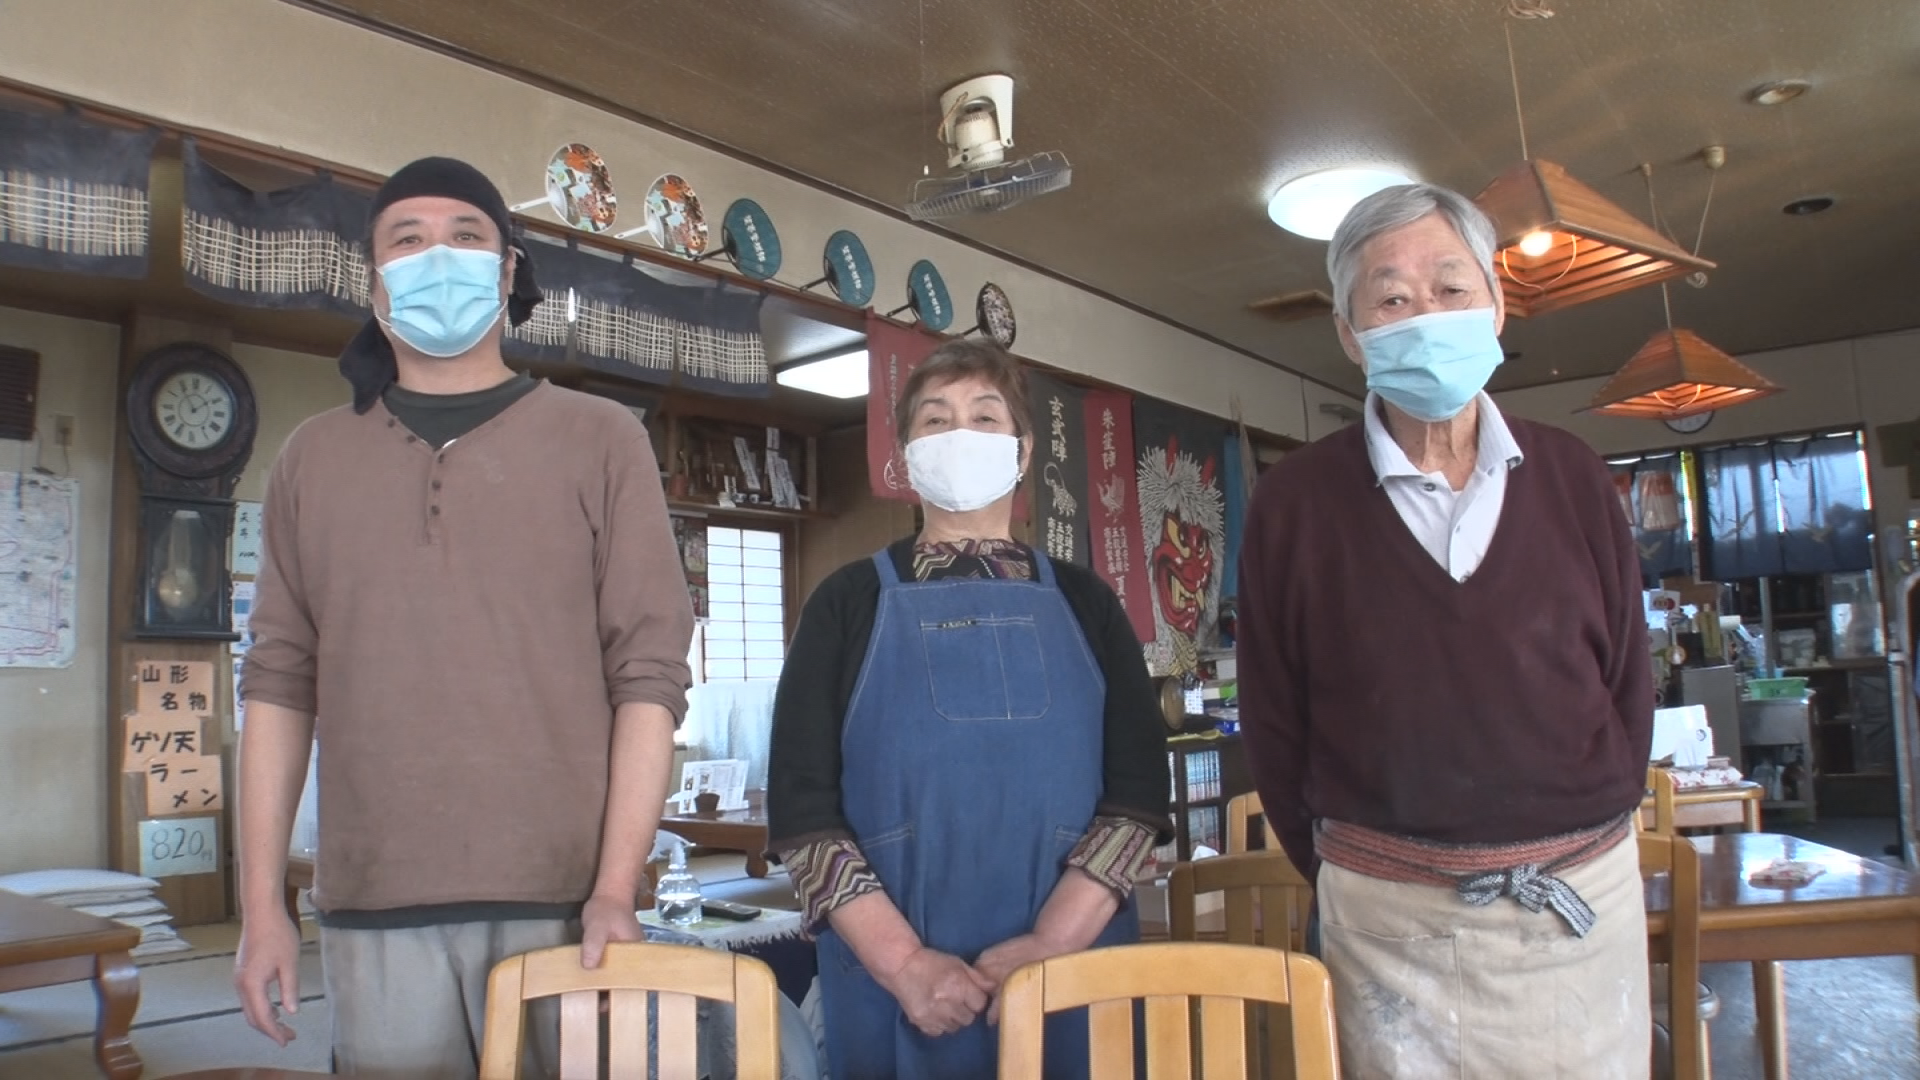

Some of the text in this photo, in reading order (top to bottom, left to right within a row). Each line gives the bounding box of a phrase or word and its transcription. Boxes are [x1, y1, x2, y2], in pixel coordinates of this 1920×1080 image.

[142, 664, 189, 685] 山形
[161, 691, 207, 712] 名物
[131, 730, 196, 754] ゲソ天
[150, 763, 199, 783] ラー
[173, 788, 218, 808] メン
